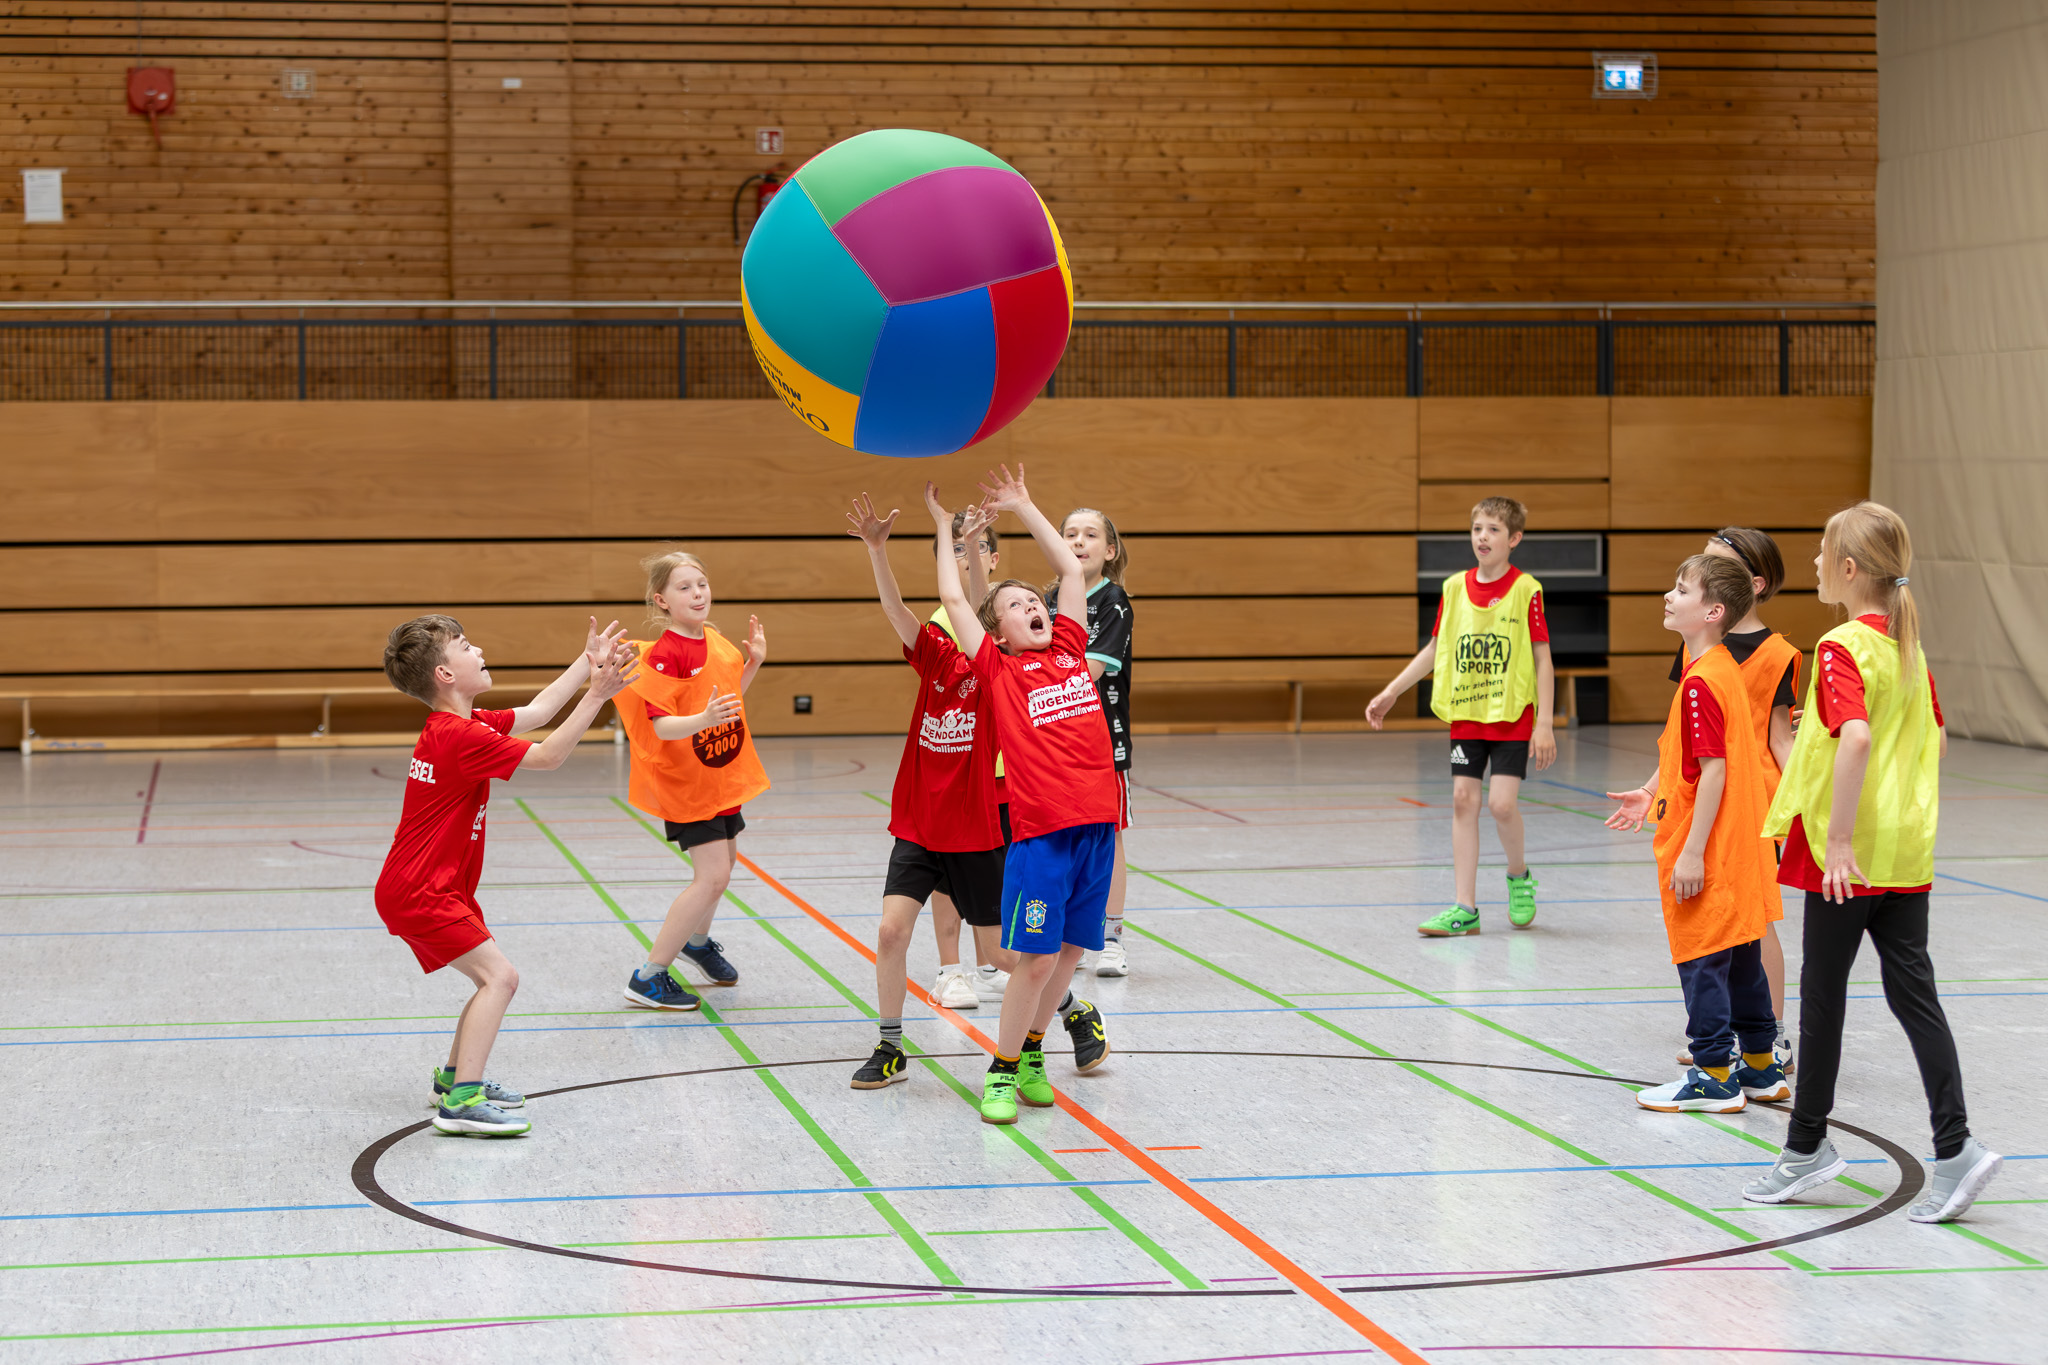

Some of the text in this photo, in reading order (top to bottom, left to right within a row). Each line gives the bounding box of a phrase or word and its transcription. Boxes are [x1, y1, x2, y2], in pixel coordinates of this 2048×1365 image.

[1460, 661, 1501, 675] SPORT
[1472, 679, 1503, 690] ziehen
[705, 733, 739, 760] 2000
